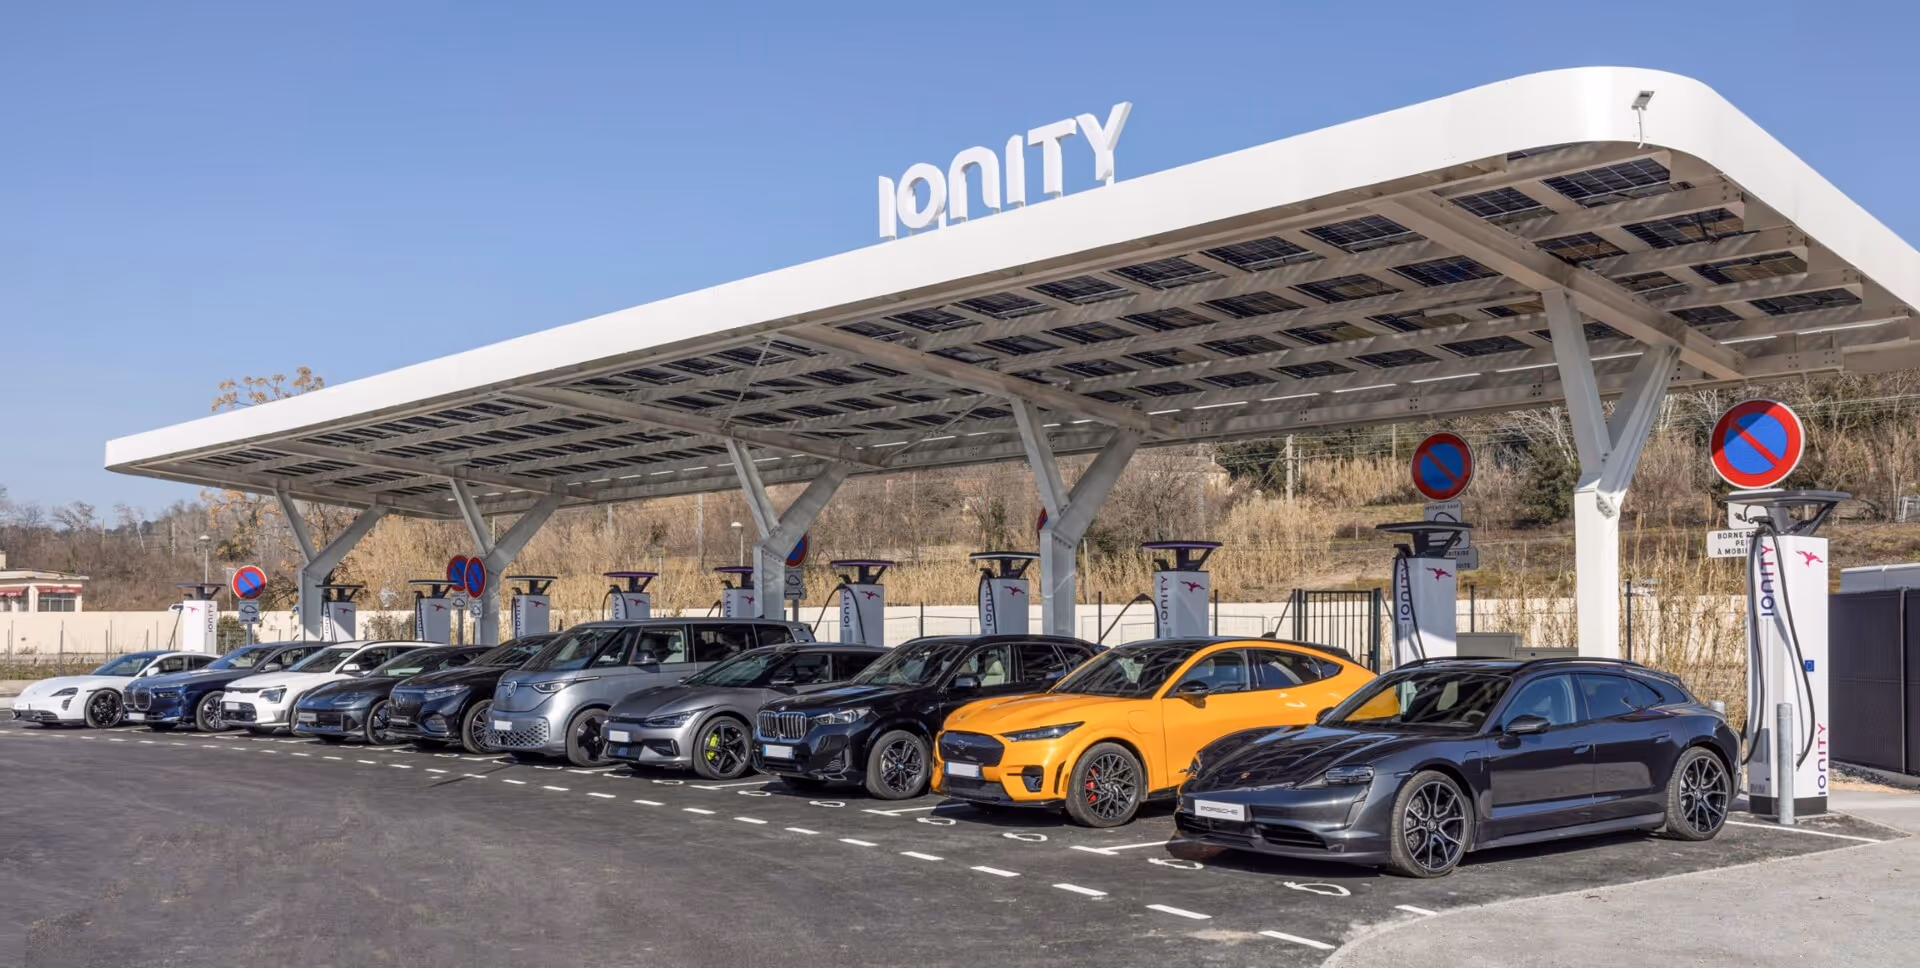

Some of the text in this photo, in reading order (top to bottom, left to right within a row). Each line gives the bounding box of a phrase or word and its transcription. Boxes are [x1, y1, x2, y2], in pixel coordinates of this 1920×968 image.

[878, 101, 1133, 240] IONITY
[1717, 531, 1744, 540] BORNE
[1761, 544, 1774, 617] IONITY
[1817, 722, 1826, 796] IONITY
